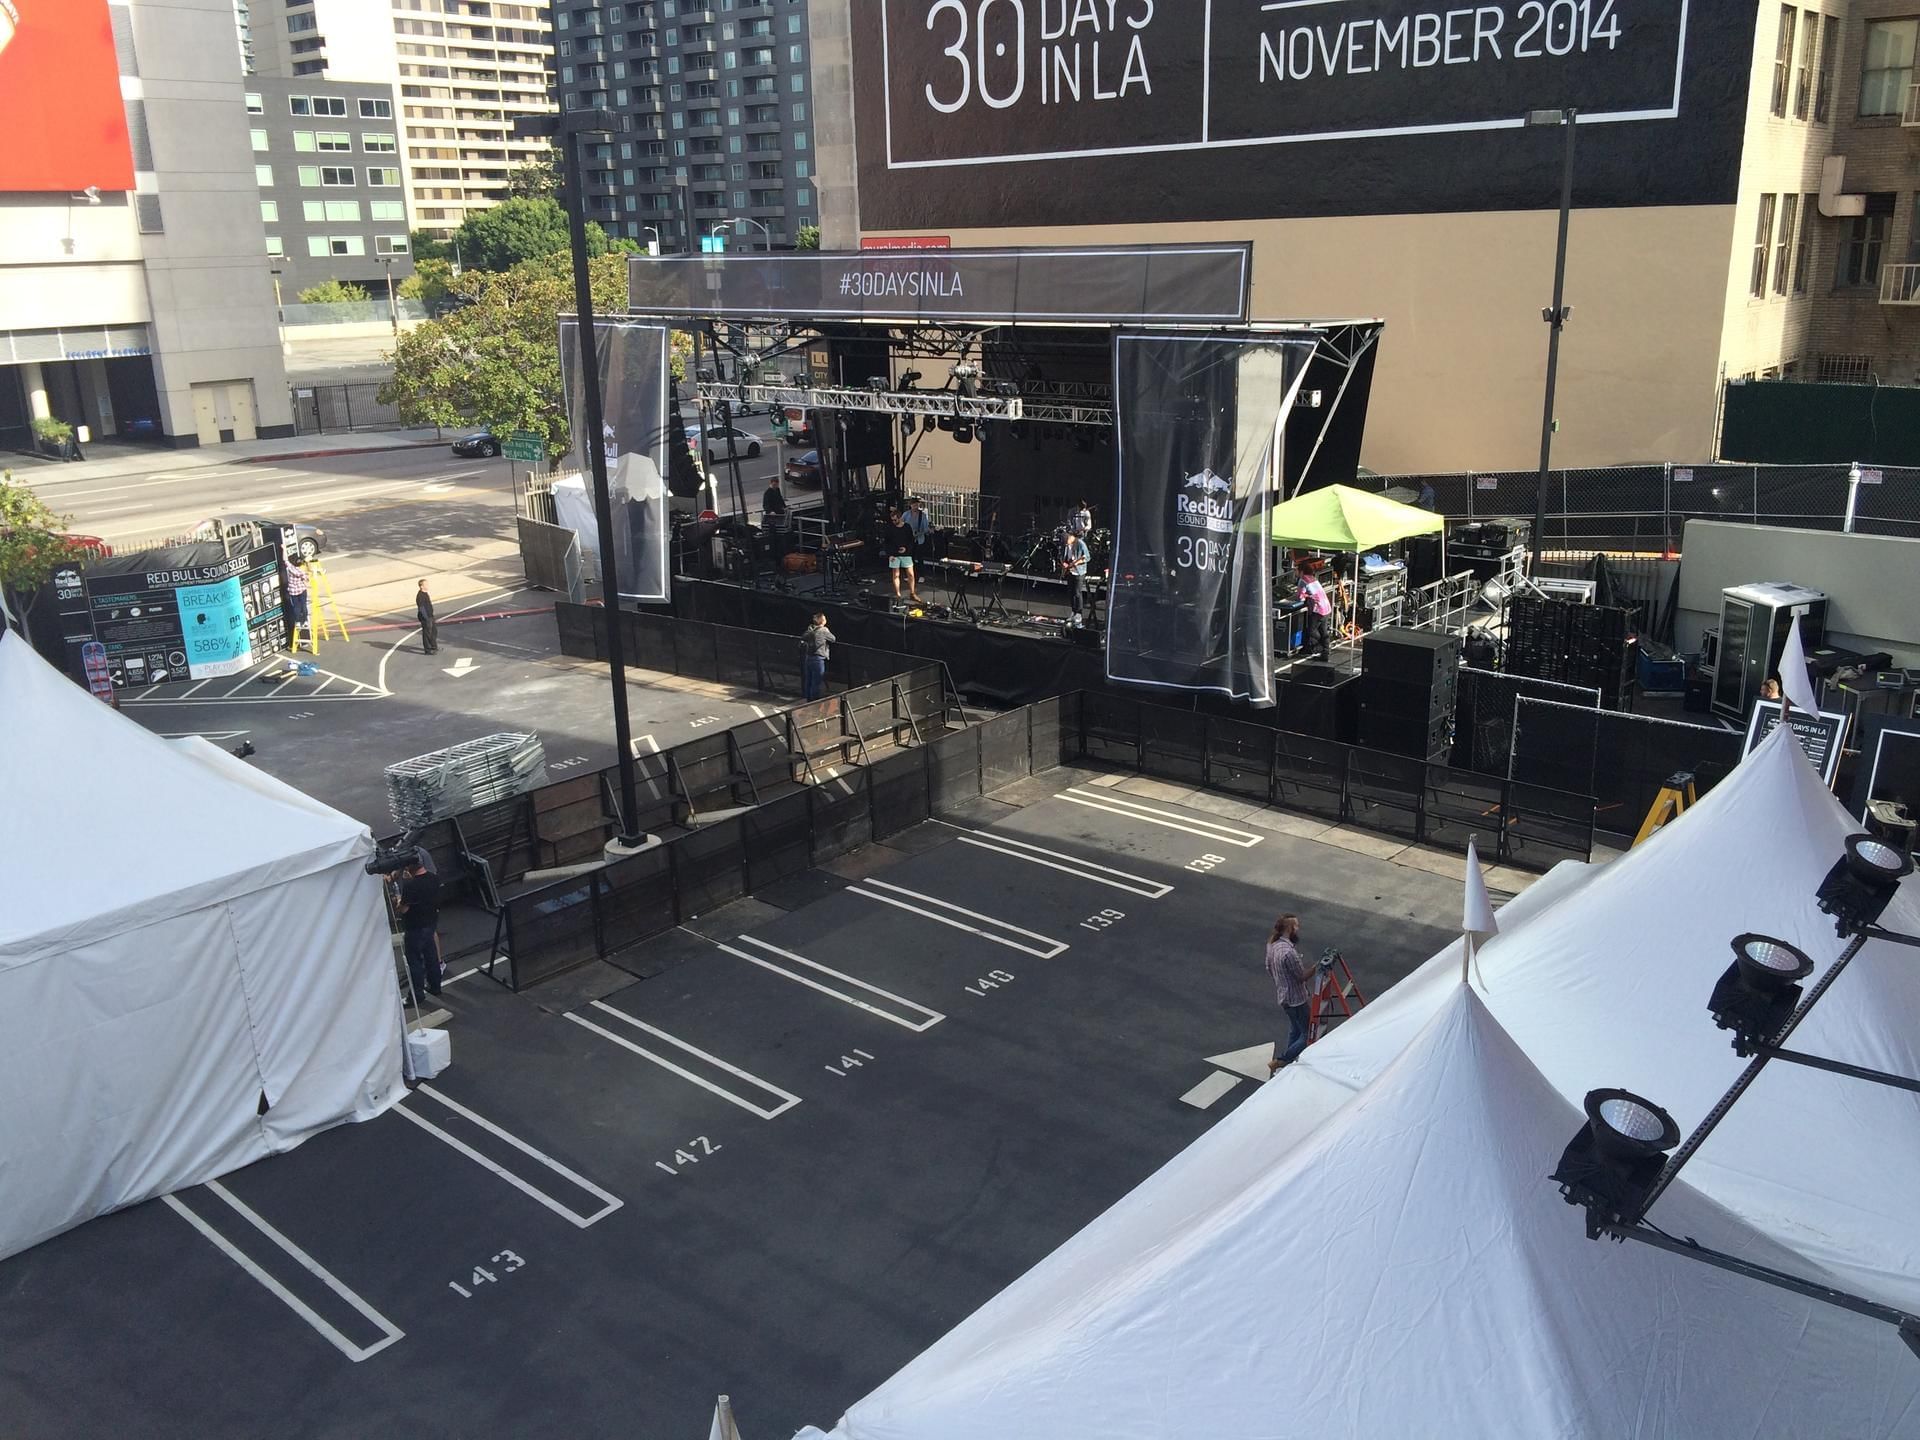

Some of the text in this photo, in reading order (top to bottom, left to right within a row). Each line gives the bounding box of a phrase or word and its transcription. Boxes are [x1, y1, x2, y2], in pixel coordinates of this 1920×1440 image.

[1259, 0, 1622, 83] NOVEMBER 2014
[925, 0, 1025, 113] 30
[1041, 34, 1152, 104] IN LA
[863, 242, 947, 250] muralmediacom
[840, 271, 963, 297] #30DAYSINLA
[1179, 515, 1206, 526] SOUND
[1177, 536, 1209, 570] 30
[1209, 540, 1231, 557] DAYS
[146, 554, 249, 584] RED BULL SOUND SELECT
[1208, 559, 1216, 572] IN
[57, 589, 71, 600] 30
[183, 593, 221, 608] BREAK
[194, 636, 231, 652] 586%
[689, 716, 720, 728] 137
[1792, 723, 1810, 733] DAYS
[550, 757, 589, 770] 136
[1184, 853, 1227, 873] 138
[1080, 908, 1126, 931] 139
[965, 969, 1015, 997] 140
[824, 1048, 875, 1077] 141
[655, 1136, 722, 1175] 142
[449, 1250, 526, 1298] 143
